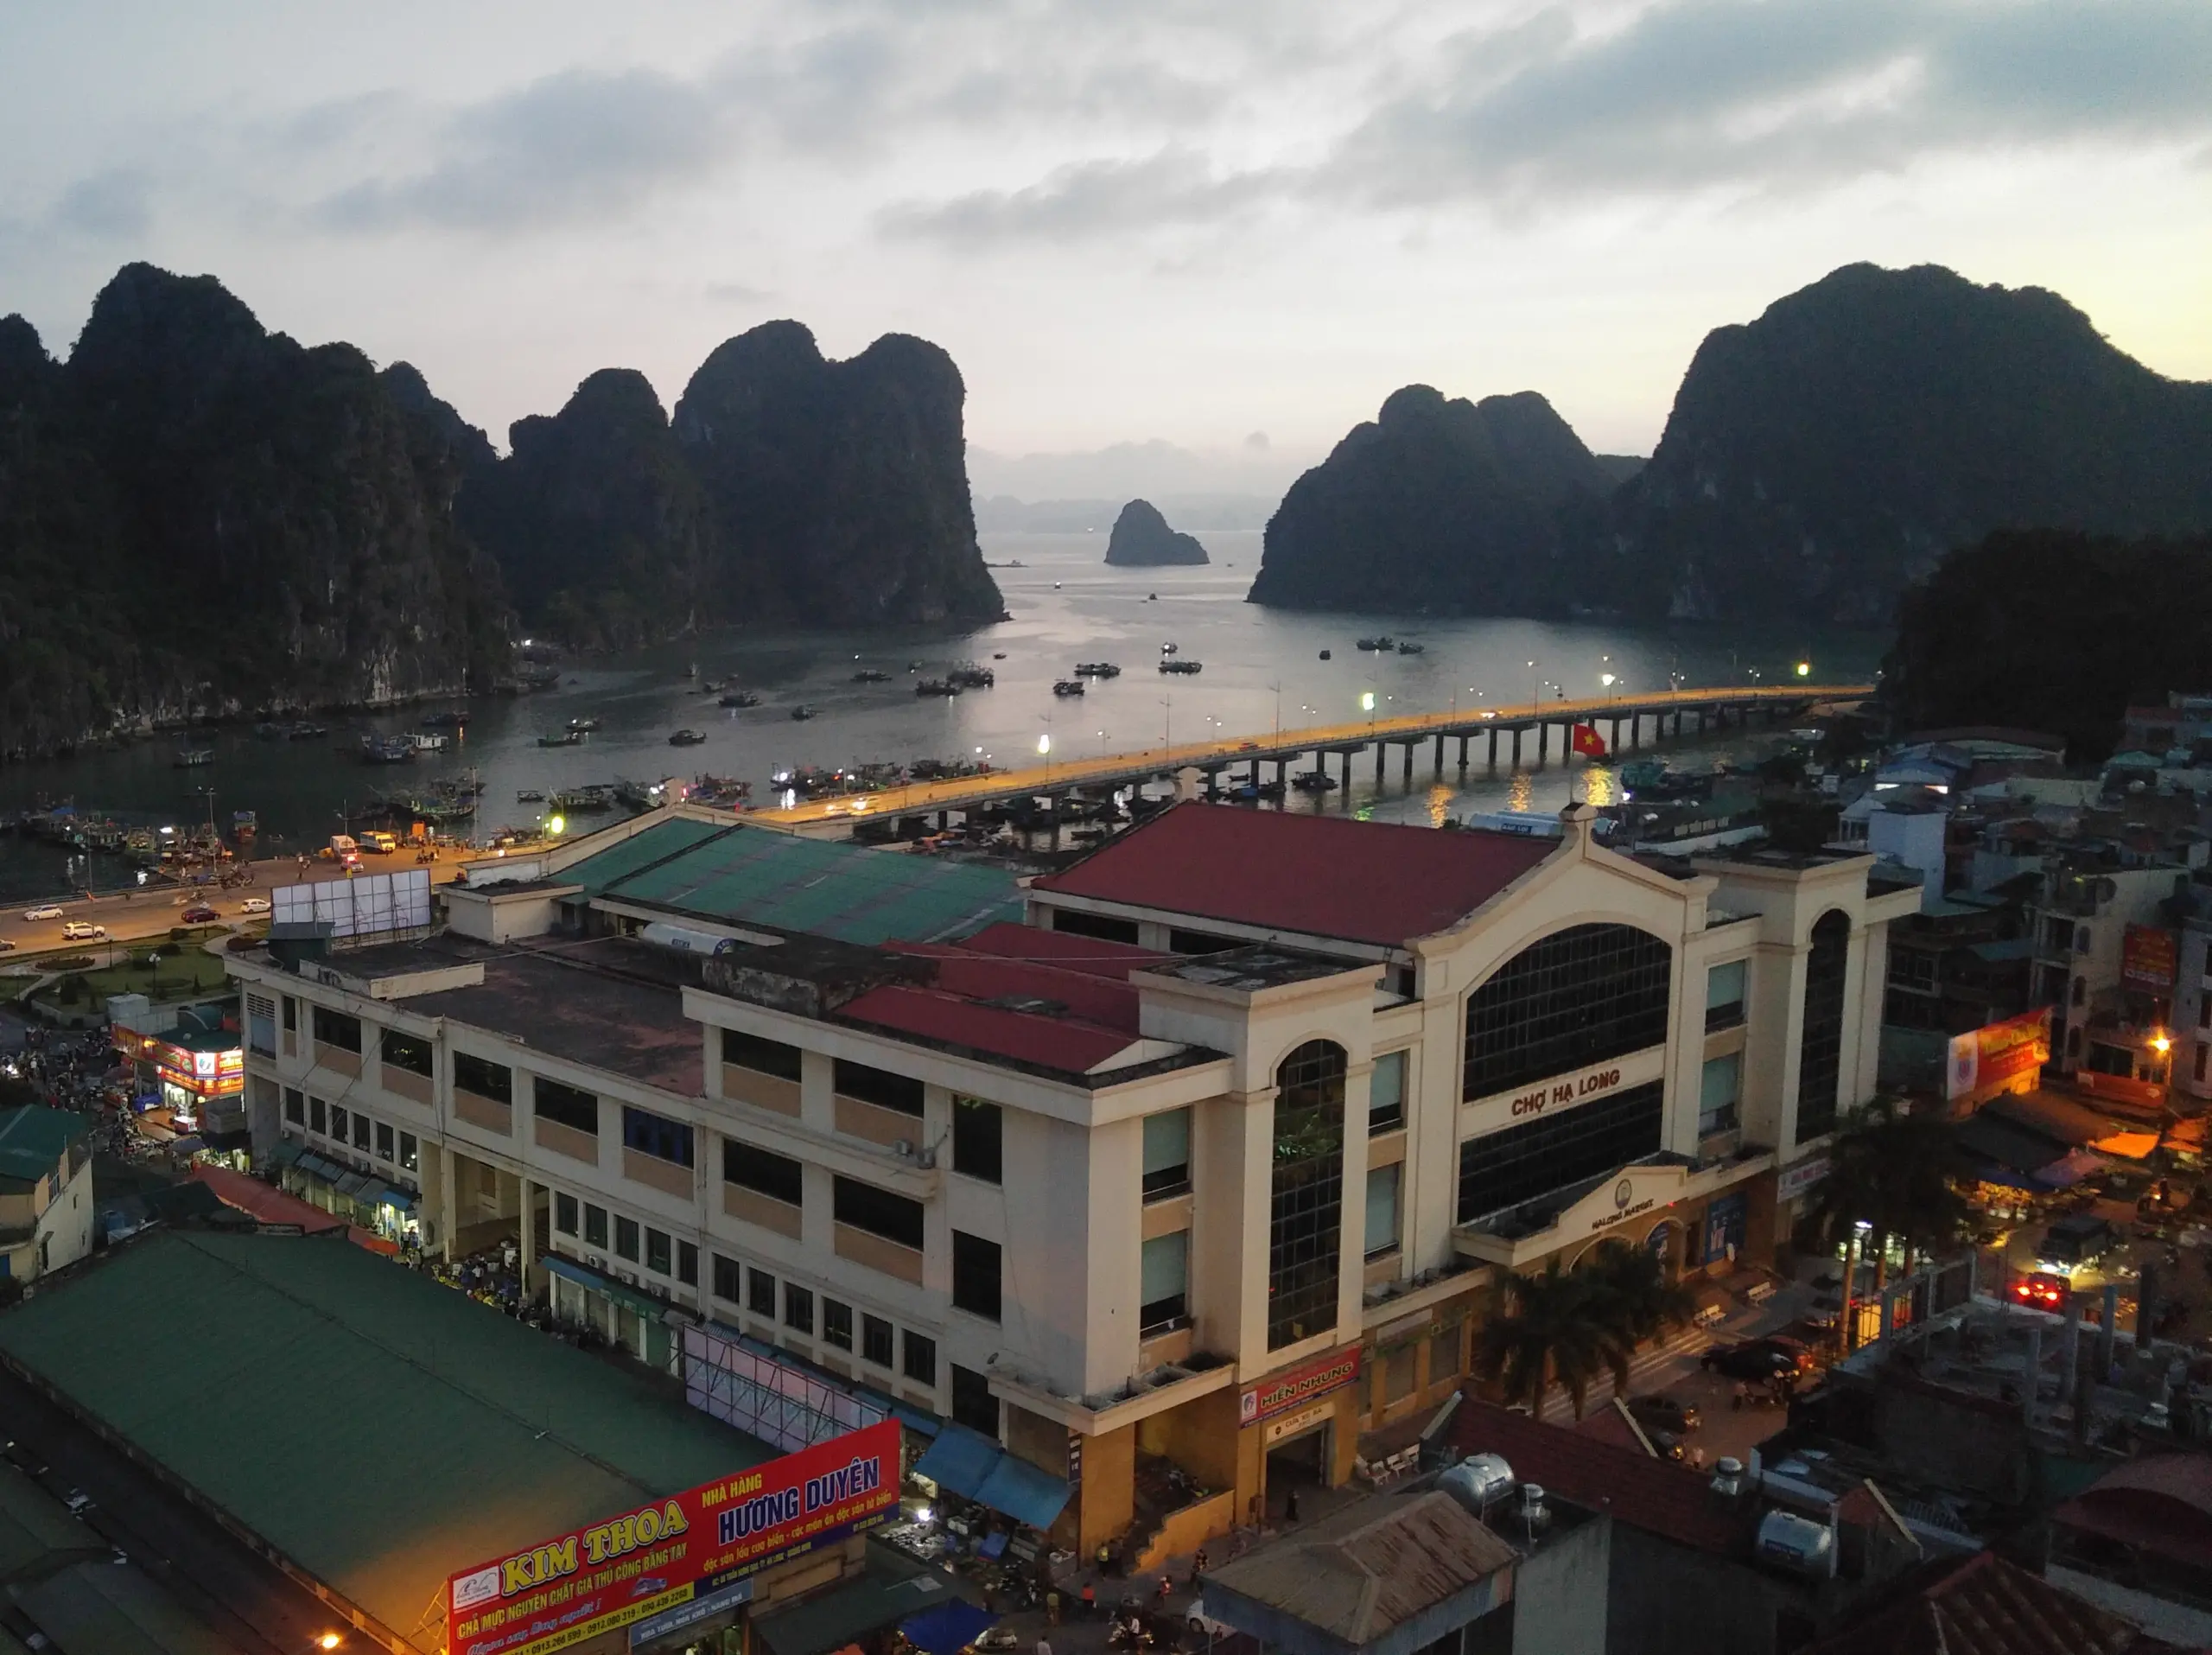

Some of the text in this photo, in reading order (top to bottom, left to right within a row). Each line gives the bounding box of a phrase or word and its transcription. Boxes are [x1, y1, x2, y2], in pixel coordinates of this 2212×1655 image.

[1511, 1069, 1620, 1116] CHỢ HẠ LONG
[1299, 1361, 1354, 1392] NHUNG
[702, 1474, 762, 1508] NHÀ HÀNG
[719, 1455, 880, 1547] HƯƠNG DUYÊN
[501, 1499, 690, 1597] KIM THOA
[721, 1550, 734, 1565] sản
[751, 1541, 765, 1553] cua
[852, 1501, 864, 1516] sản
[457, 1613, 480, 1640] CHẢ
[480, 1608, 505, 1633] MỰC
[507, 1592, 548, 1621] NGUYÊN
[549, 1580, 575, 1607] CHẤT
[594, 1563, 613, 1591] THỦ
[615, 1559, 643, 1583] CÔNG
[669, 1542, 688, 1563] TAY
[622, 1608, 636, 1622] 319
